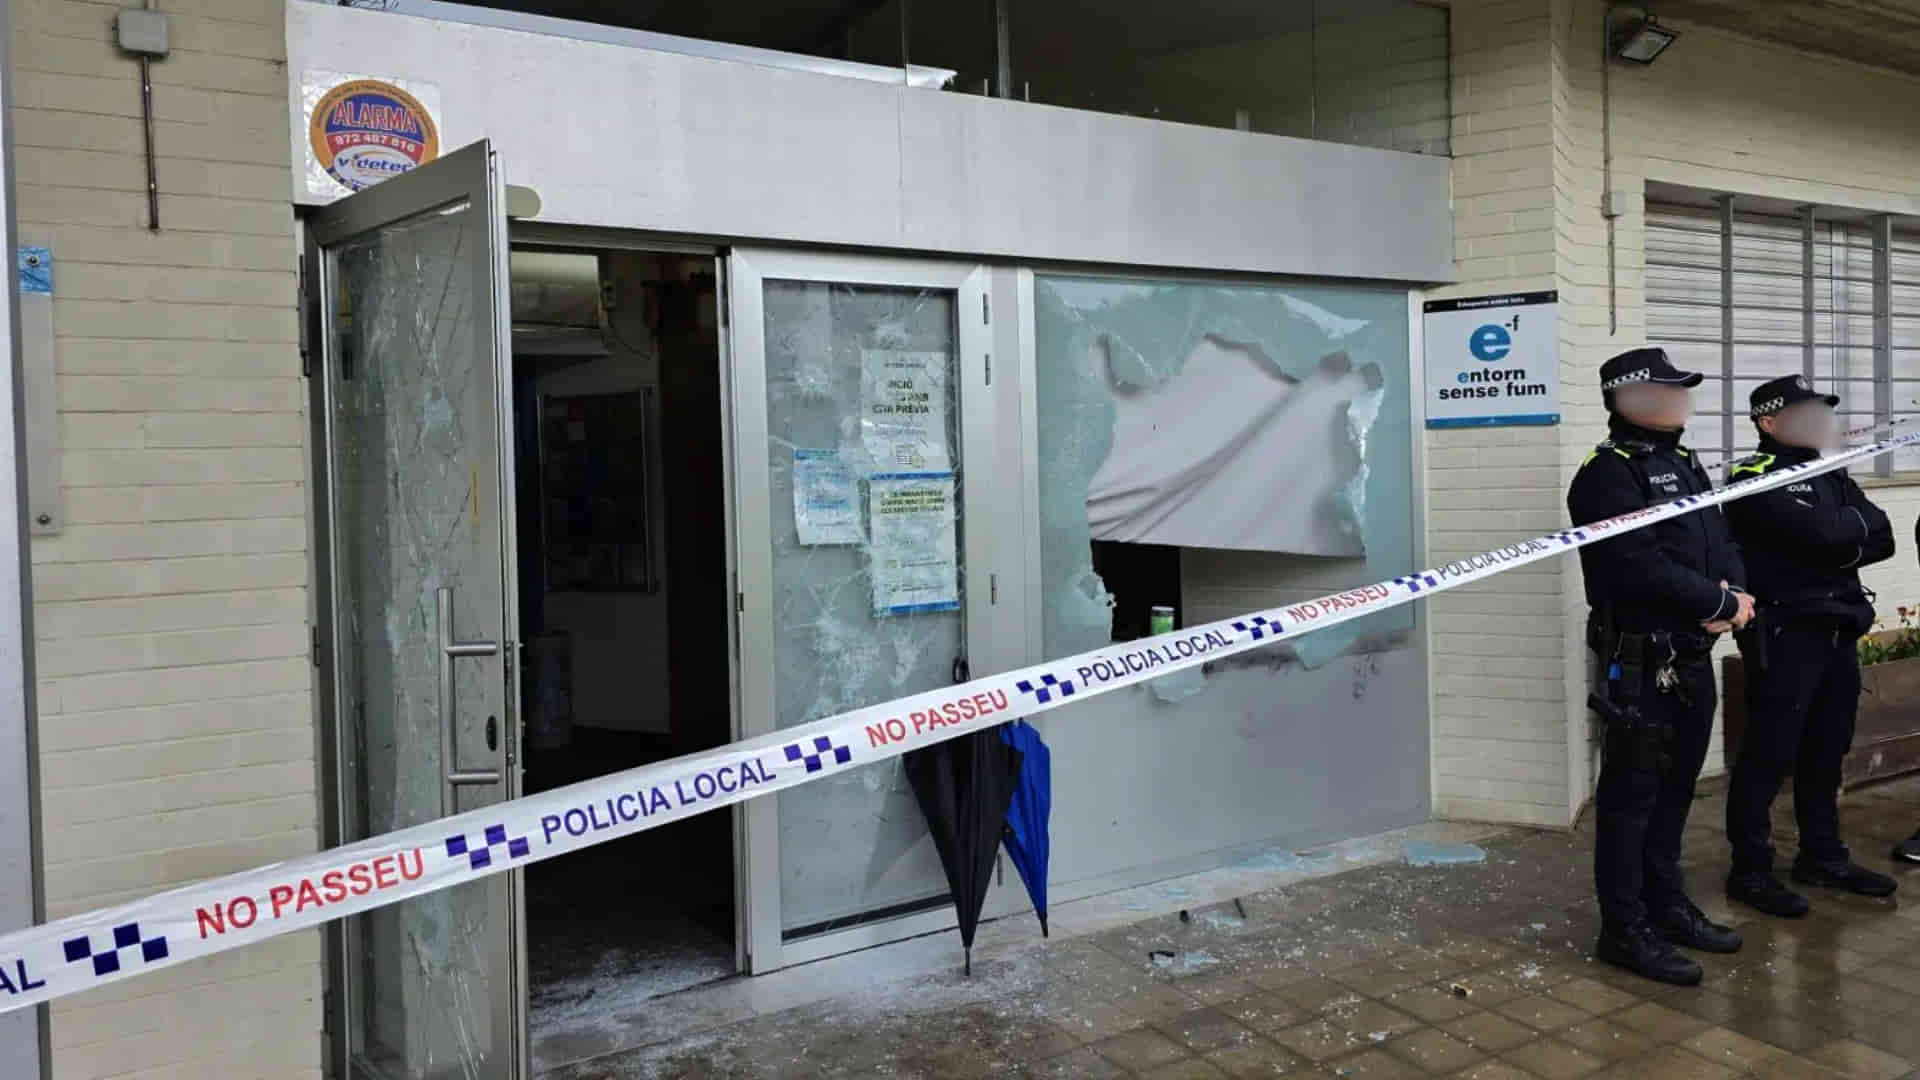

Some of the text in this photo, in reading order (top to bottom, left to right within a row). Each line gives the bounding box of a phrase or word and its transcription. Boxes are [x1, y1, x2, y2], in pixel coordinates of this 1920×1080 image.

[333, 100, 417, 133] ALARMA
[335, 134, 362, 146] 972
[338, 153, 414, 174] videtec
[1439, 382, 1547, 400] sense fum
[1457, 368, 1525, 383] entorn
[1436, 540, 1549, 581] POLICIA LOCAL
[1287, 583, 1389, 624] NO PASSEU
[1077, 628, 1233, 688] POLICIA LOCAL
[864, 688, 1009, 748] NO PASSEU
[541, 757, 776, 844] POLICIA LOCAL
[194, 847, 425, 939] NO PASSEU
